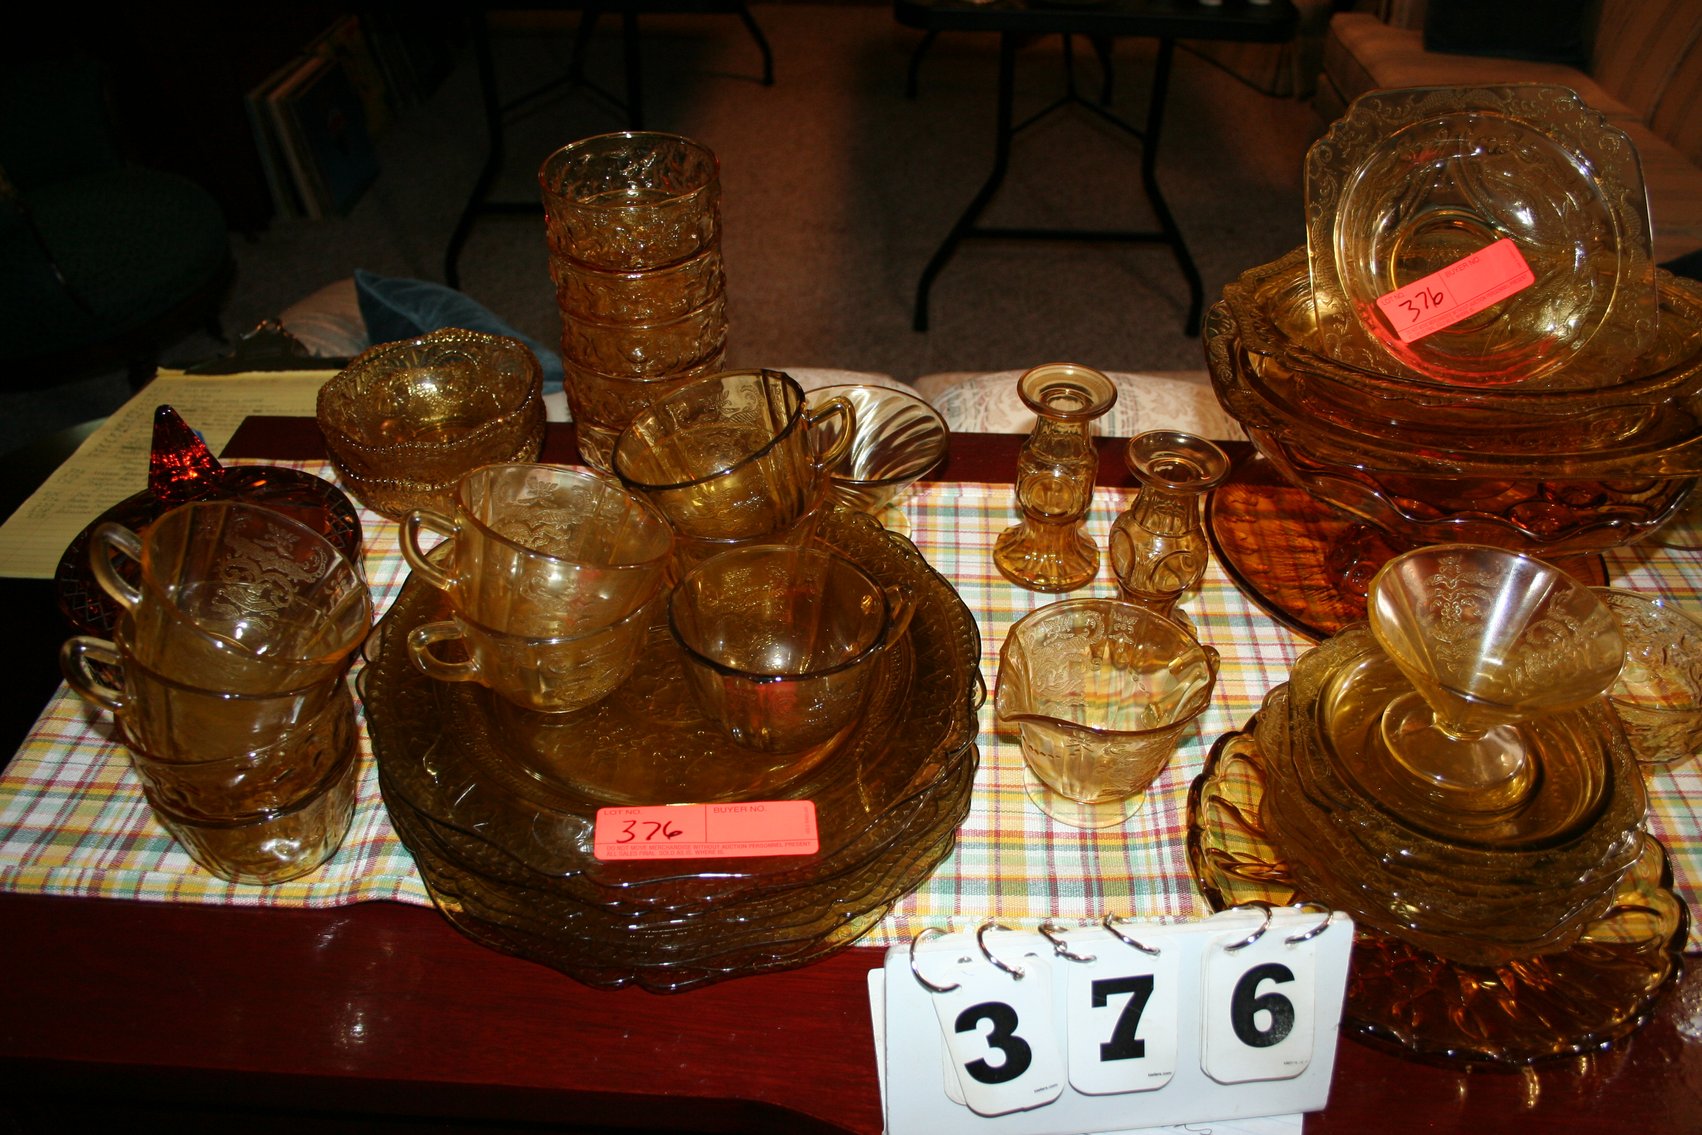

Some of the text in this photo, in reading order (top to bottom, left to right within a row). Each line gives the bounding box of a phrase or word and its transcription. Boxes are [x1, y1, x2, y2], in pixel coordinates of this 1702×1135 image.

[1445, 261, 1469, 278] BUYER
[1381, 295, 1396, 306] LOT
[1398, 287, 1444, 322] 376
[713, 806, 747, 814] BUYER
[616, 820, 683, 844] 376
[954, 962, 1295, 1084] 3 7 6
